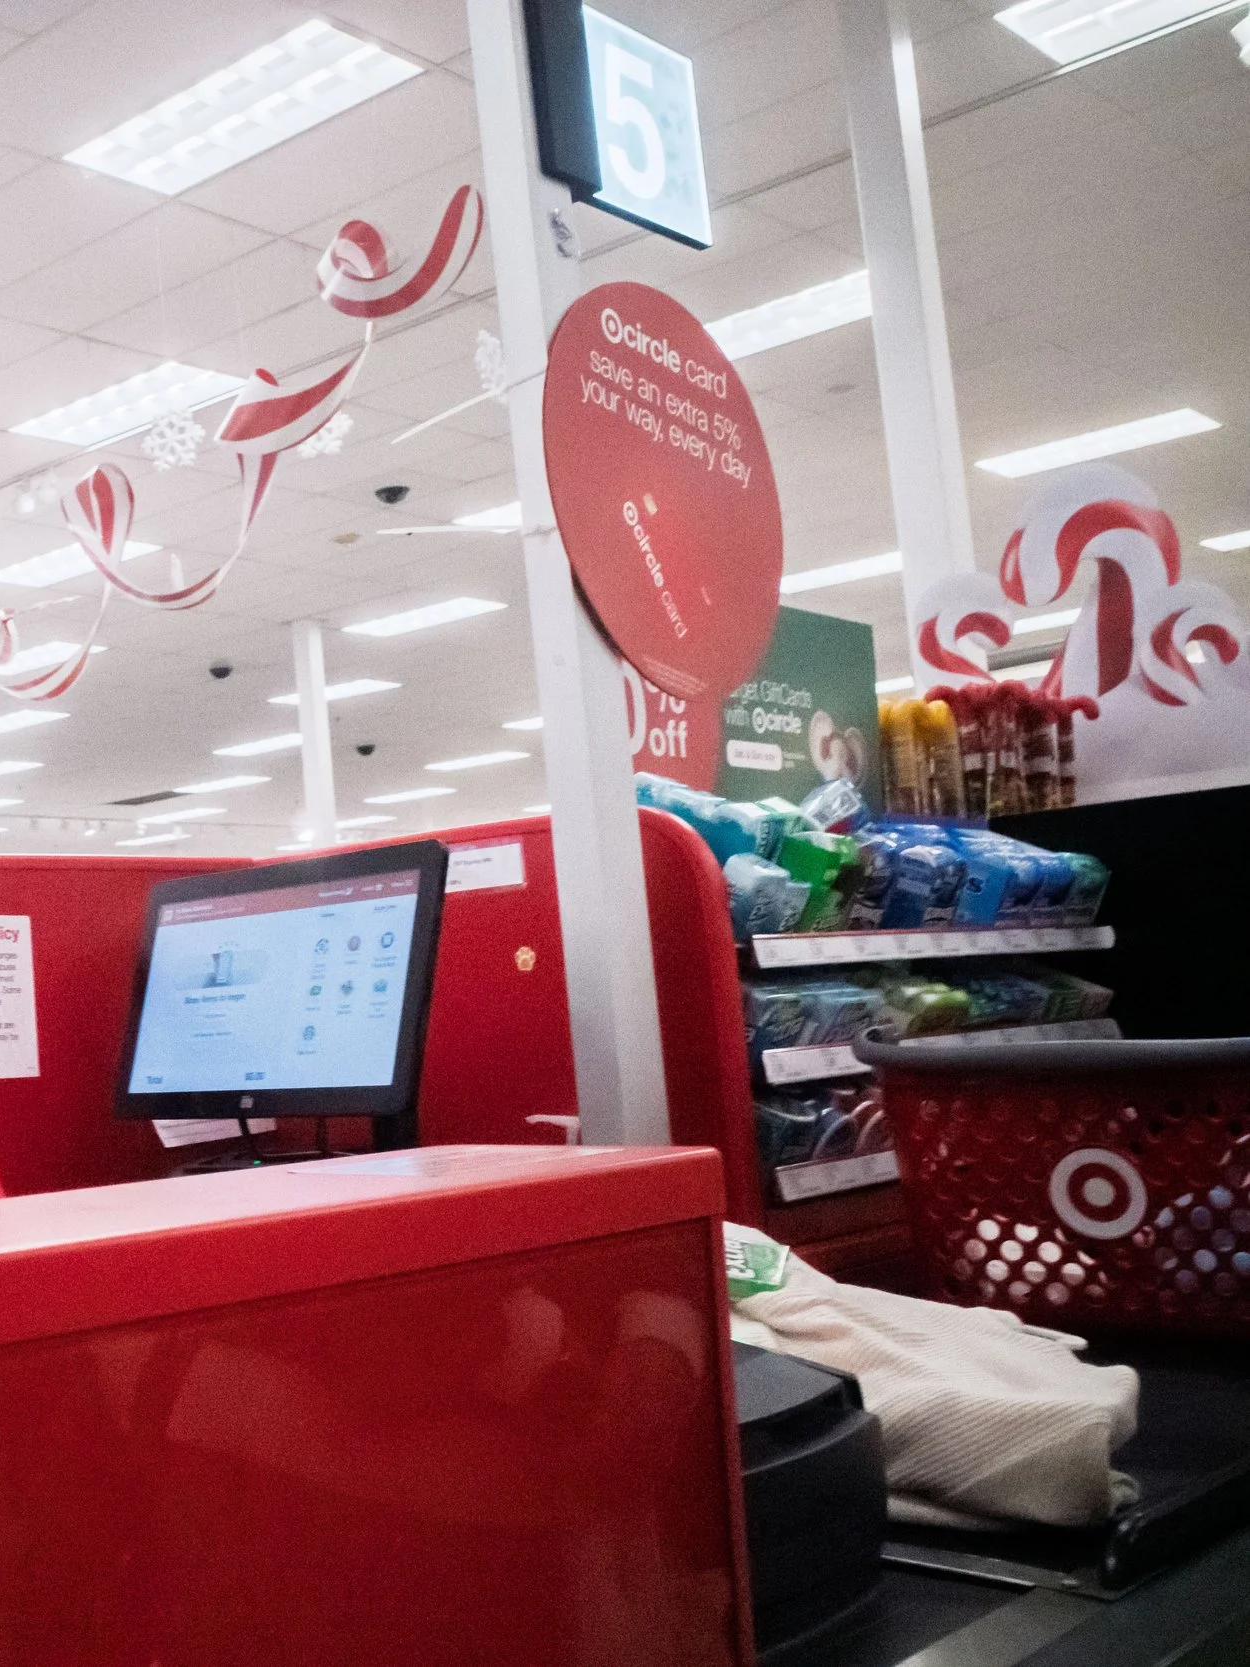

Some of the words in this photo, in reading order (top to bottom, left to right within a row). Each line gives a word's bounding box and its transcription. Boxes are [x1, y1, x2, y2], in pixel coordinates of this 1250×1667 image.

[605, 41, 667, 200] 5
[589, 350, 634, 391] save
[637, 374, 662, 405] an
[665, 389, 709, 432] extra
[712, 413, 742, 451] 5%
[622, 323, 682, 374] circle
[685, 357, 728, 400] card
[580, 375, 620, 412] your
[625, 400, 664, 443] way,
[669, 421, 717, 472] every
[720, 446, 752, 489] day
[632, 523, 665, 588] circle
[660, 589, 689, 640] card
[649, 719, 688, 758] off
